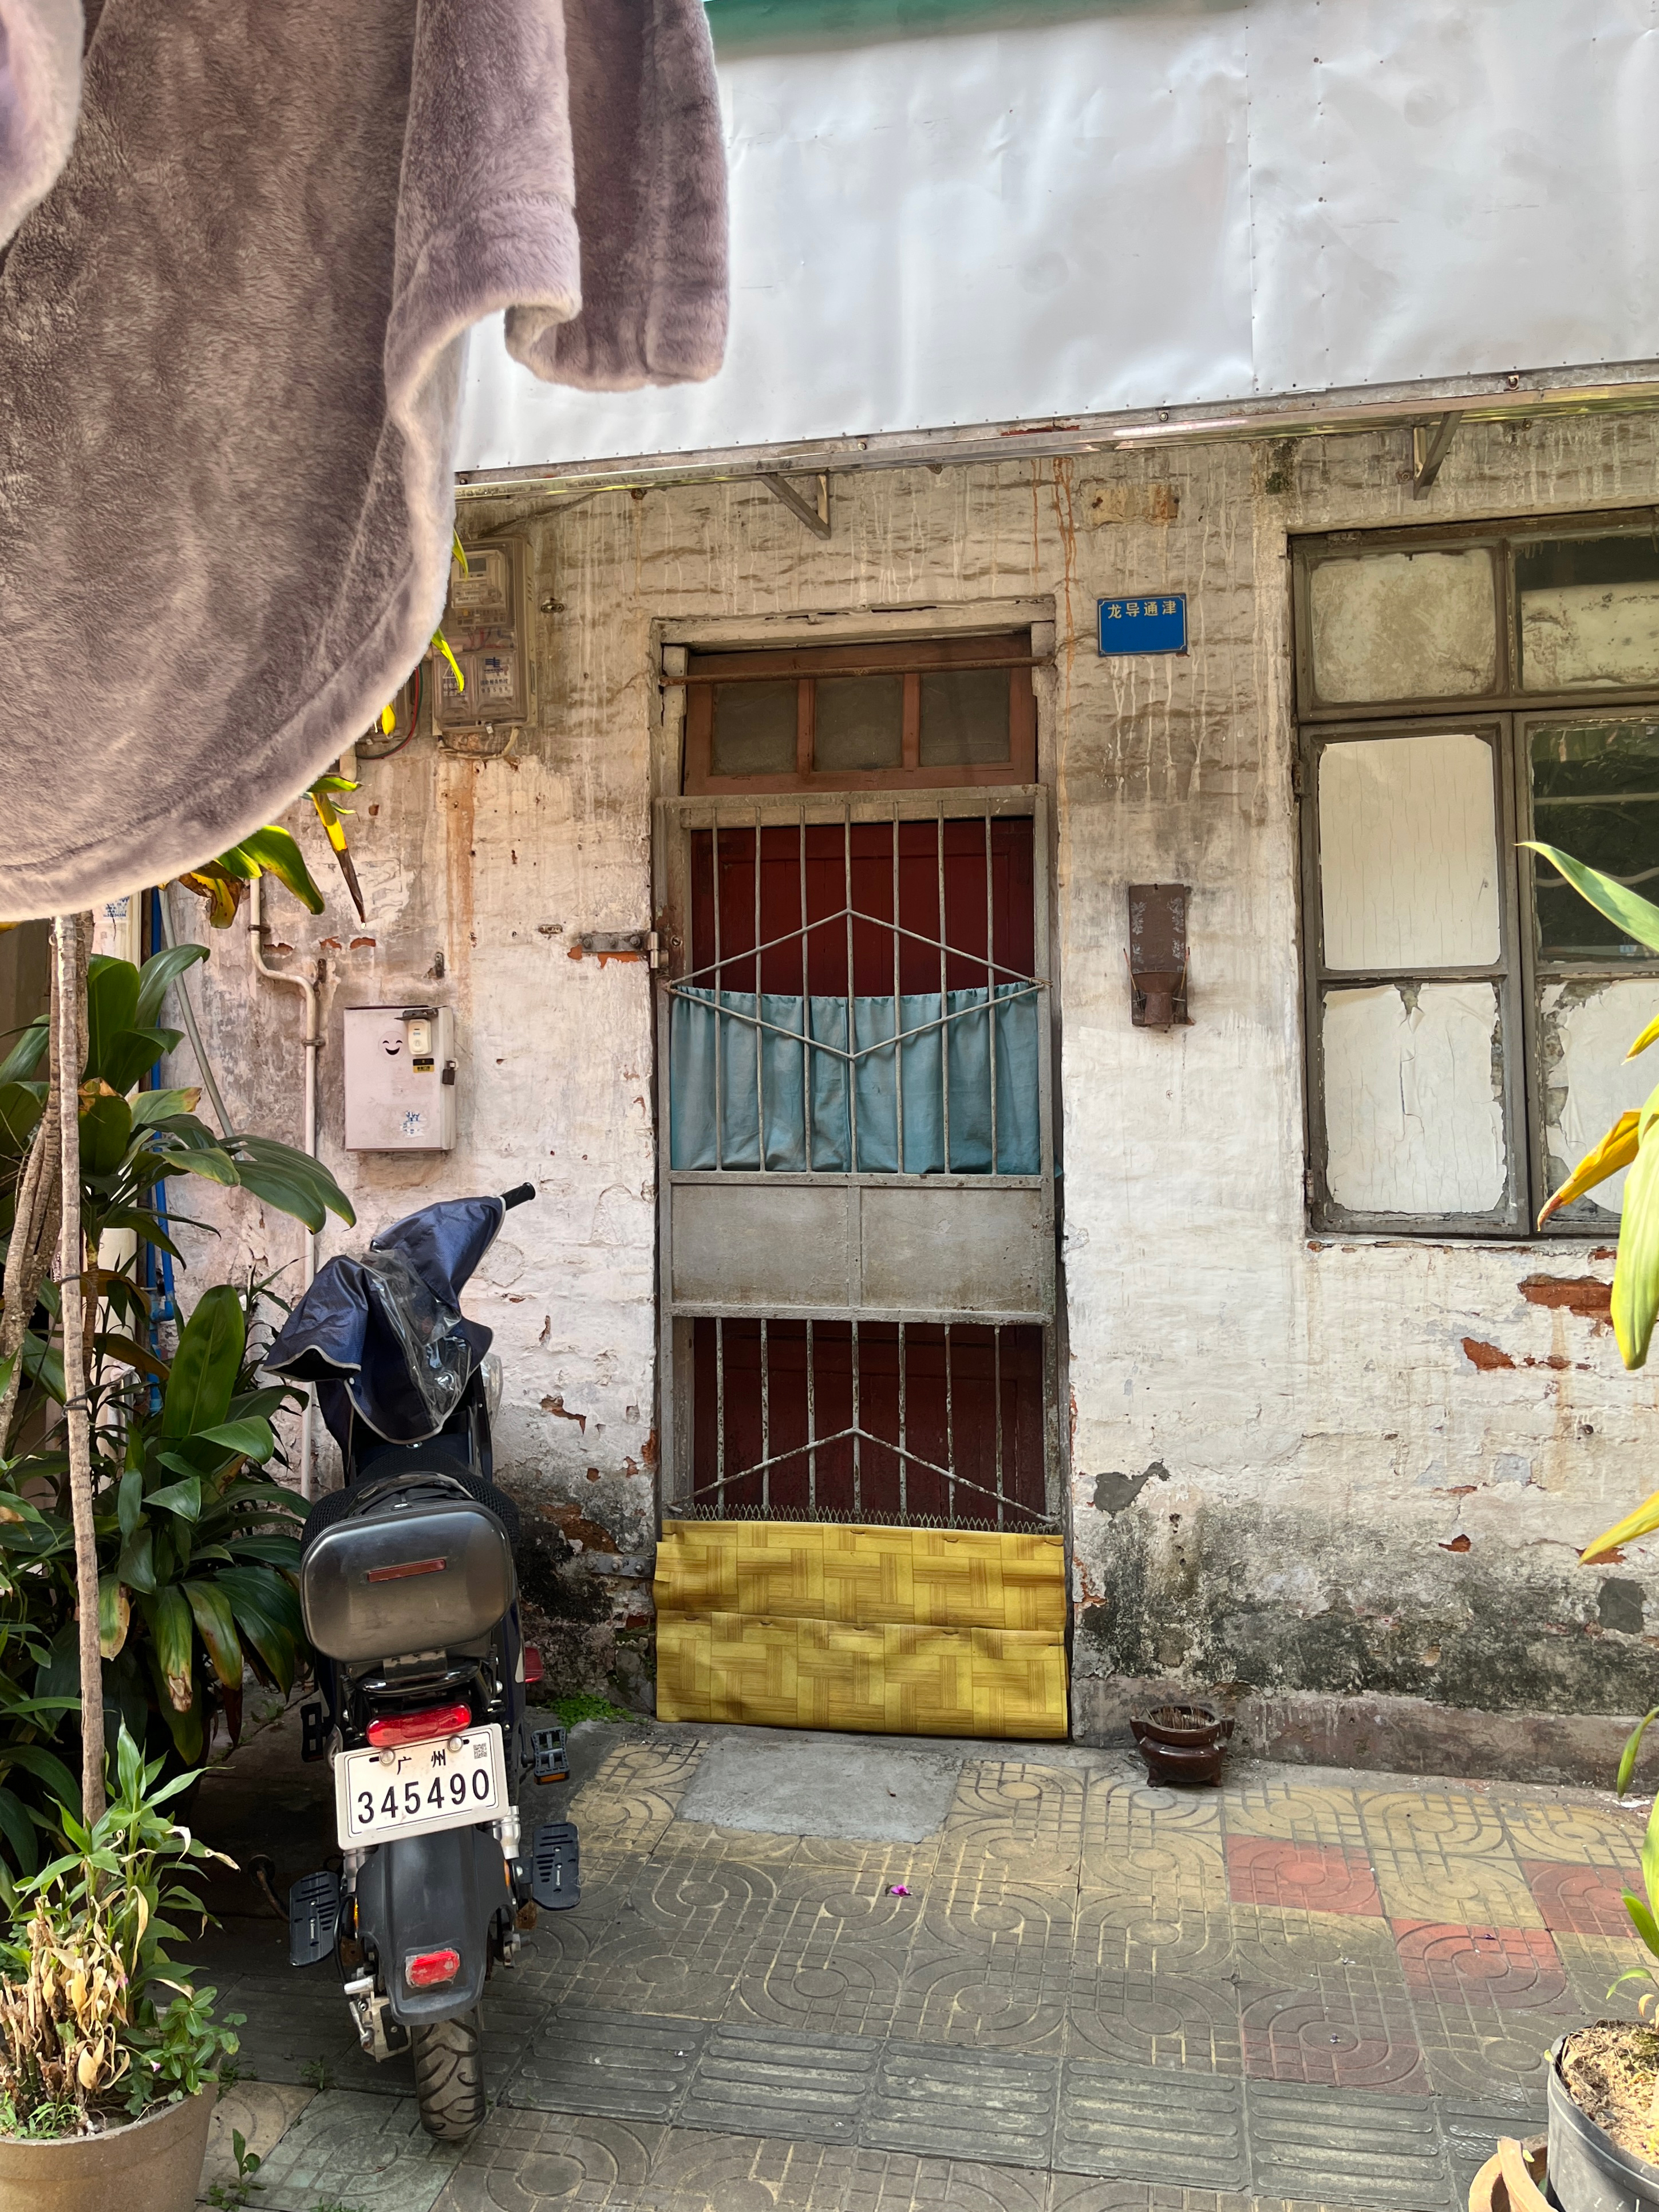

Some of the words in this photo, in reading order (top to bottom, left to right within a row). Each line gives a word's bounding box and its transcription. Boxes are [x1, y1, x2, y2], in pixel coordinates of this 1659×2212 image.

[1108, 600, 1176, 619] 龙导通津
[397, 1749, 447, 1775] 广州
[358, 1768, 489, 1824] 345490
